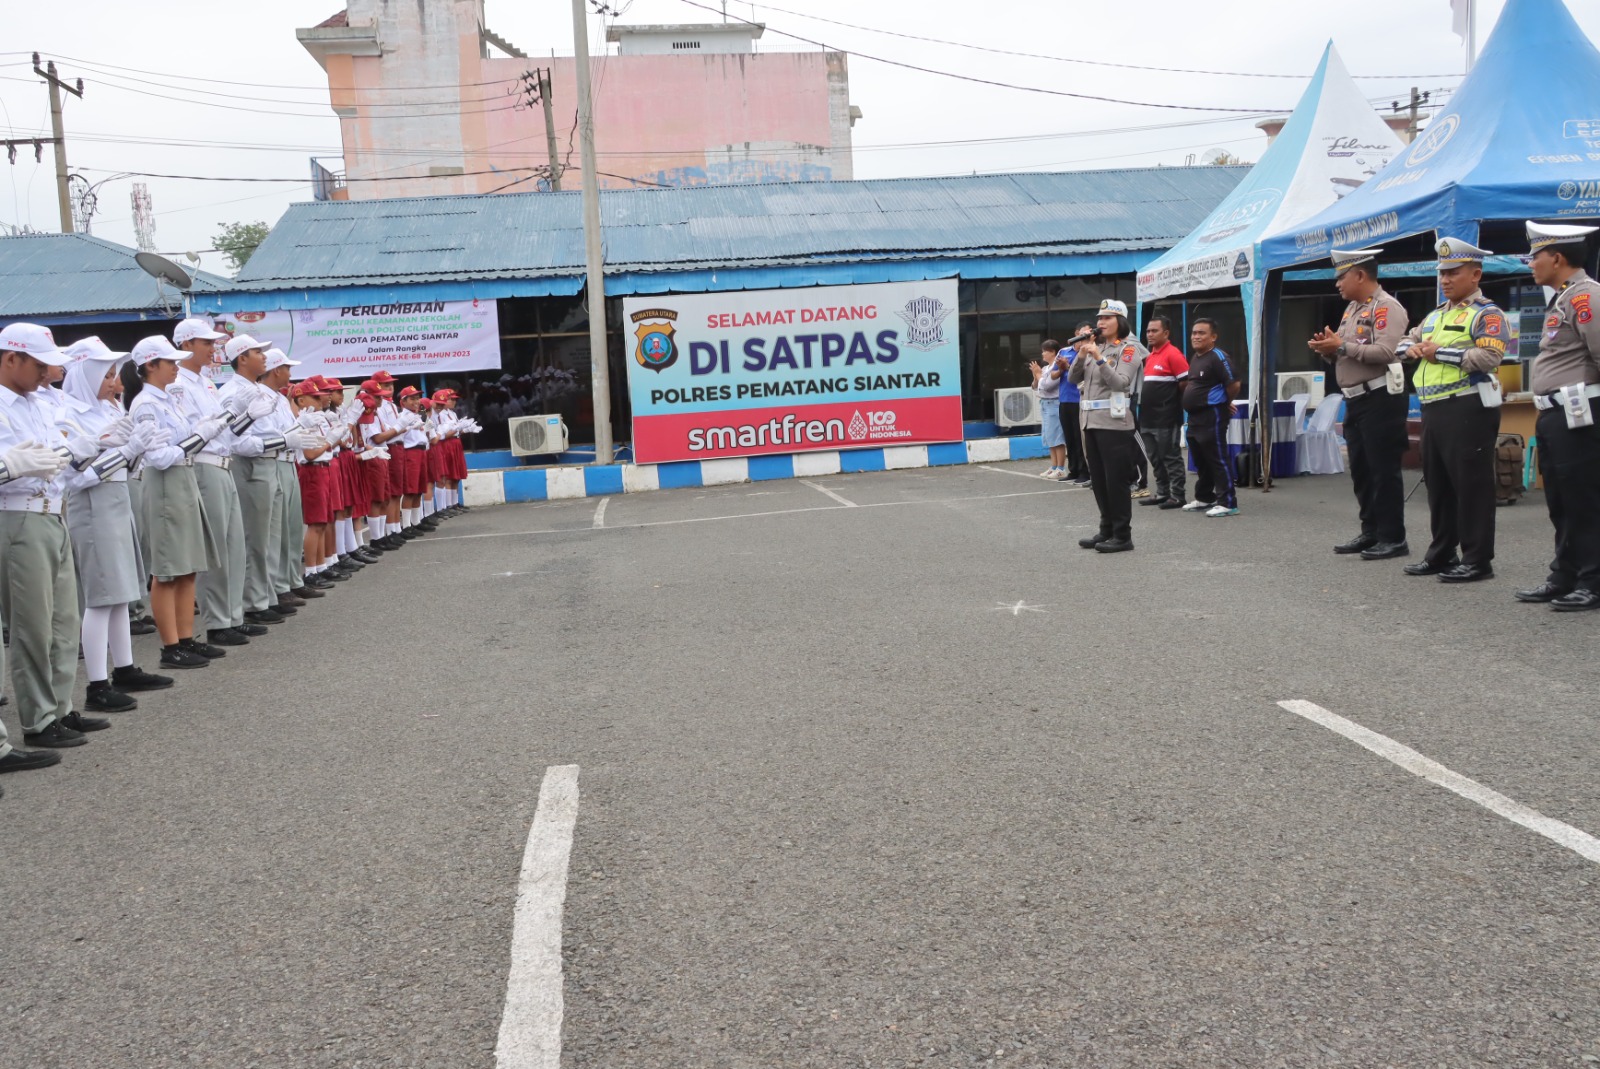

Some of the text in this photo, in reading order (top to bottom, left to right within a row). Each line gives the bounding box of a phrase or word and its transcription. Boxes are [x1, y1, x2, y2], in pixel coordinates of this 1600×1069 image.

[1578, 181, 1600, 198] YA
[340, 302, 445, 317] PERLOMBAAN
[632, 310, 676, 321] SUMATERA UTARA
[707, 304, 877, 329] SELAMAT DATANG
[326, 314, 461, 327] PATROLI KEAMANAN SEKOLAH
[306, 328, 345, 337] TINGKAT
[346, 328, 366, 336] SMA
[376, 325, 405, 334] POLISI
[407, 324, 429, 333] CILIK
[432, 322, 469, 331] TINGKAT
[471, 321, 483, 329] SD
[344, 336, 368, 344] KOTA
[370, 334, 419, 343] PEMATANG
[421, 332, 459, 341] SIANTAR
[367, 344, 427, 354] Dalam Rangka
[688, 329, 900, 376] DI SATPAS
[346, 355, 367, 363] LALU
[368, 354, 397, 362] LINTAS
[423, 351, 451, 359] TAHUN
[452, 350, 471, 358] 2023
[651, 371, 941, 405] POLRES PEMATANG SIANTAR
[687, 413, 845, 451] smartfren
[869, 430, 912, 439] INDONESIA
[870, 424, 896, 432] UNTUK
